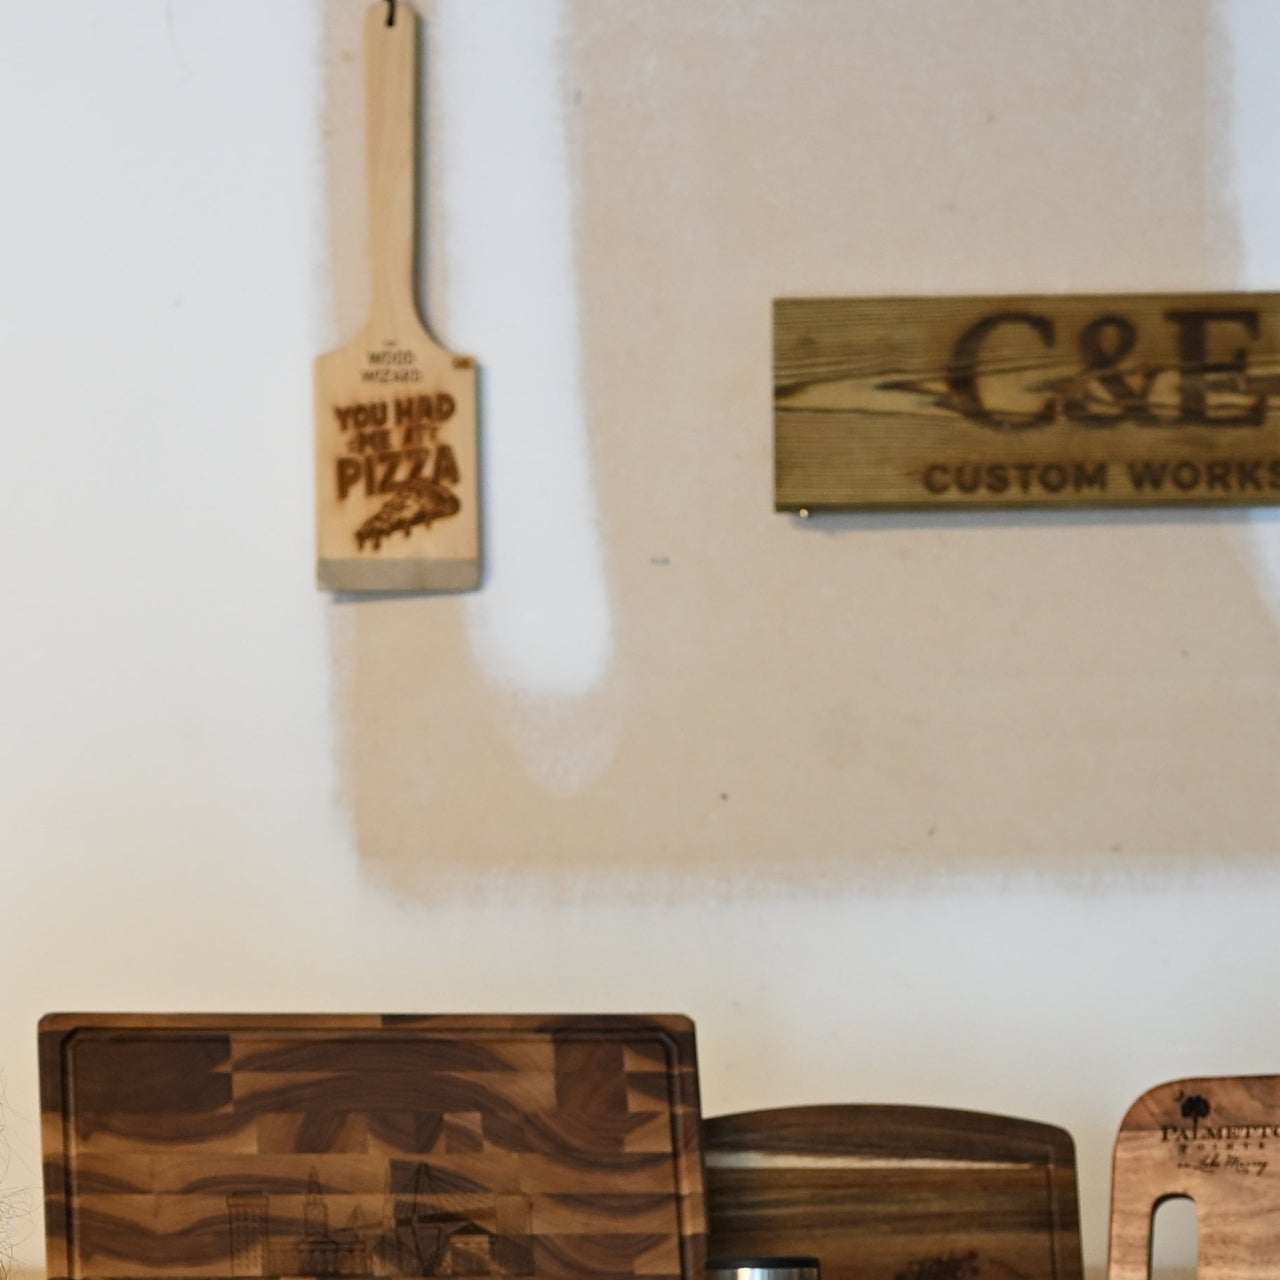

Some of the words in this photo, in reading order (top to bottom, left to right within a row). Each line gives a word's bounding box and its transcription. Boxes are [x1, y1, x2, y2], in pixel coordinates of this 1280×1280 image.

[947, 309, 1269, 432] C&E
[335, 402, 388, 432] YOU
[394, 393, 456, 425] HAD
[336, 444, 460, 501] PIZZA
[923, 461, 1109, 496] CUSTOM
